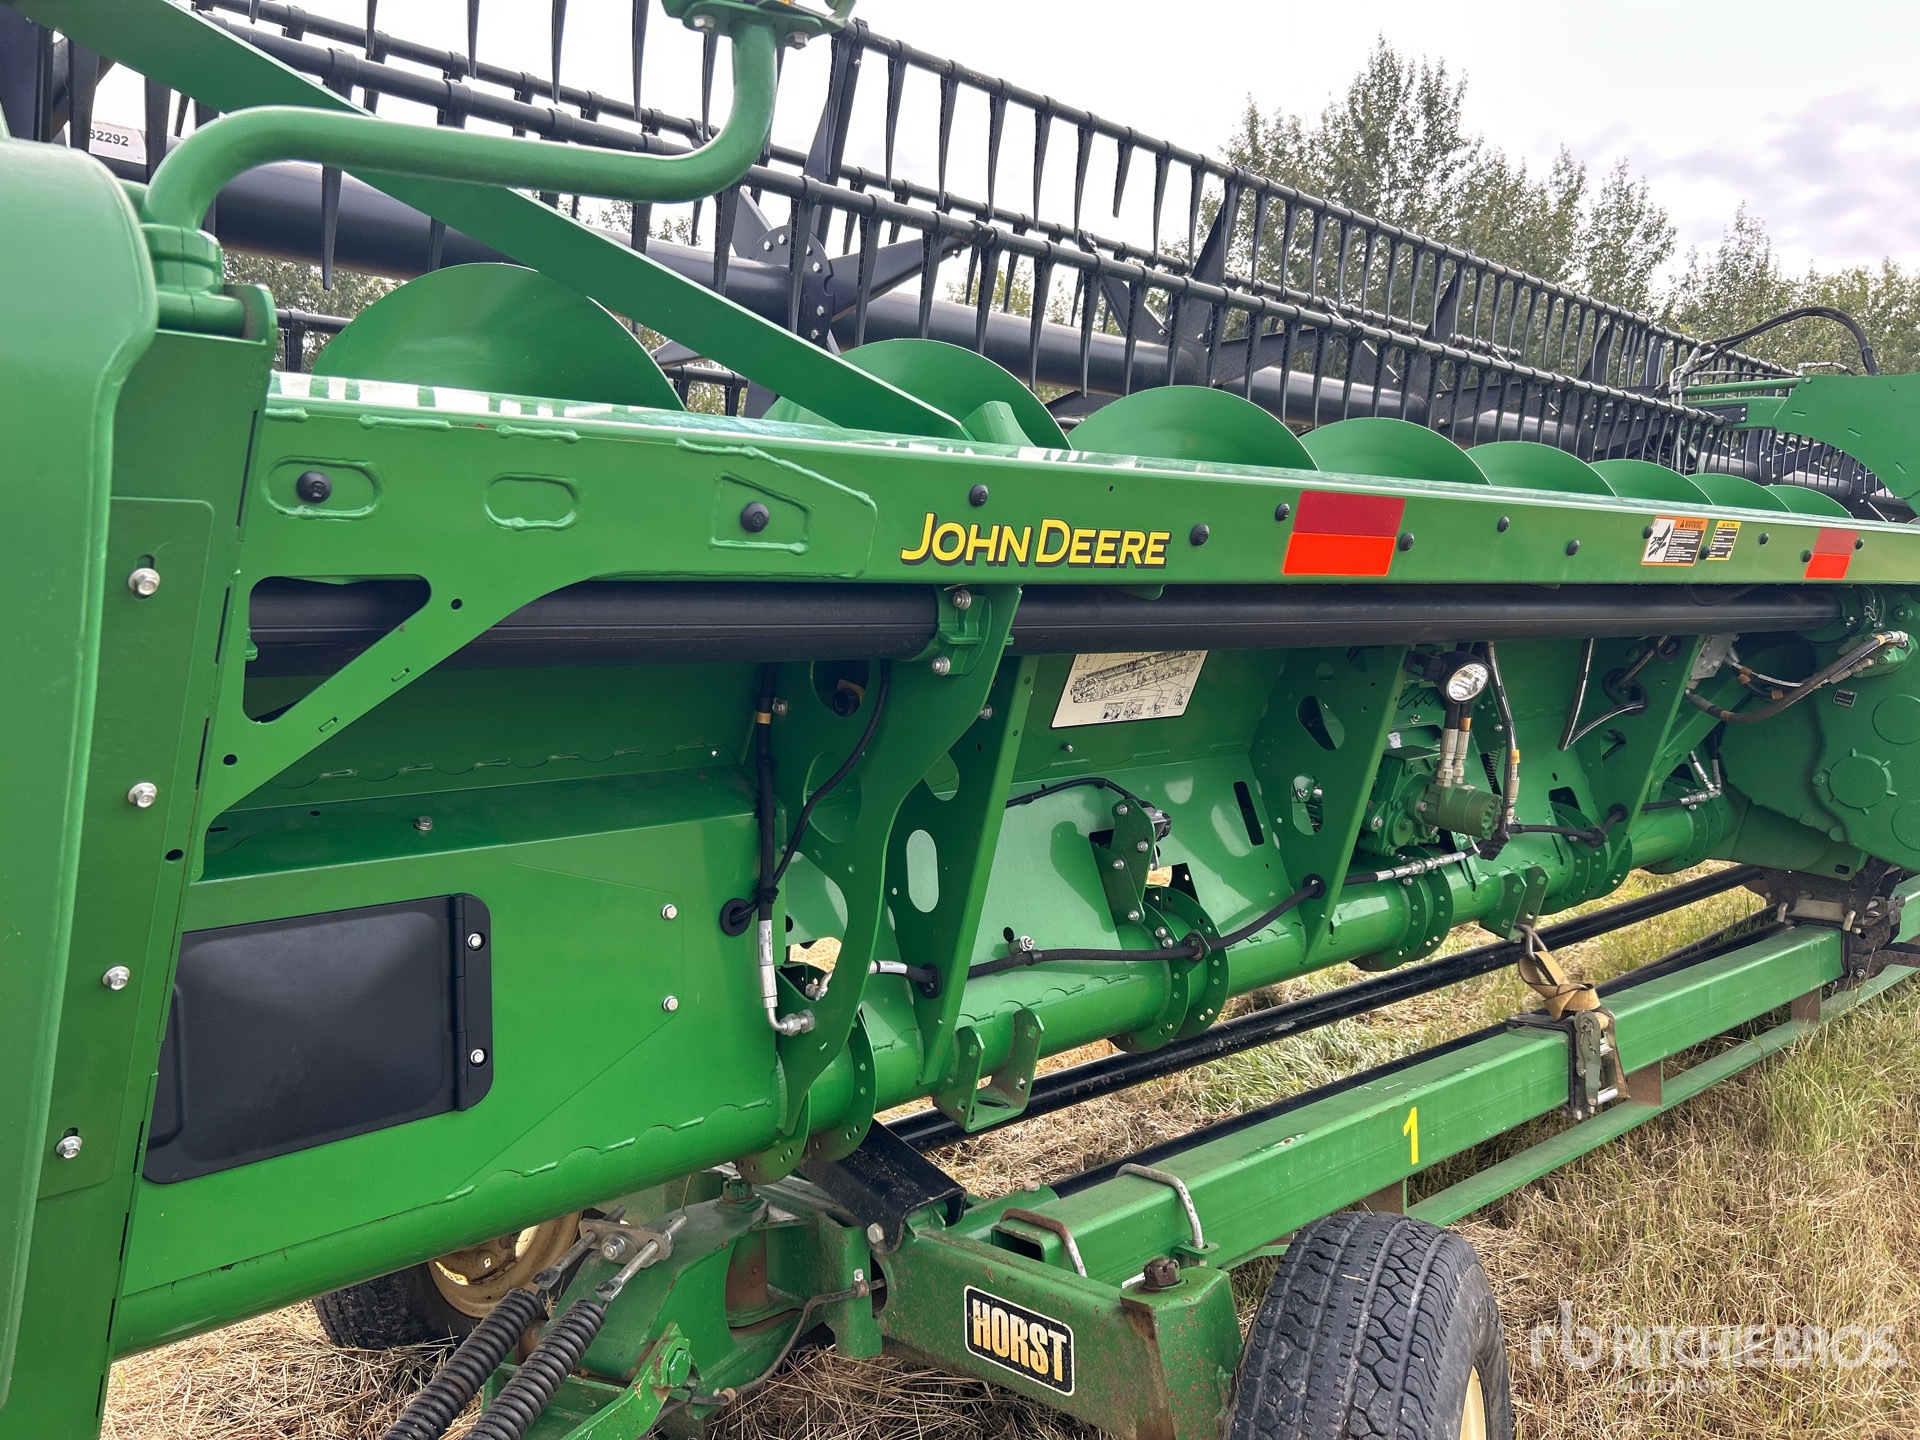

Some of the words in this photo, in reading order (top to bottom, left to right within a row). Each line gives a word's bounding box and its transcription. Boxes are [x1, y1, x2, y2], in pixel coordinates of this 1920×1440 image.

[901, 512, 1033, 567] JOHN
[1034, 518, 1172, 569] DEERE
[1403, 1106, 1419, 1166] 1
[972, 1298, 1067, 1383] HORST
